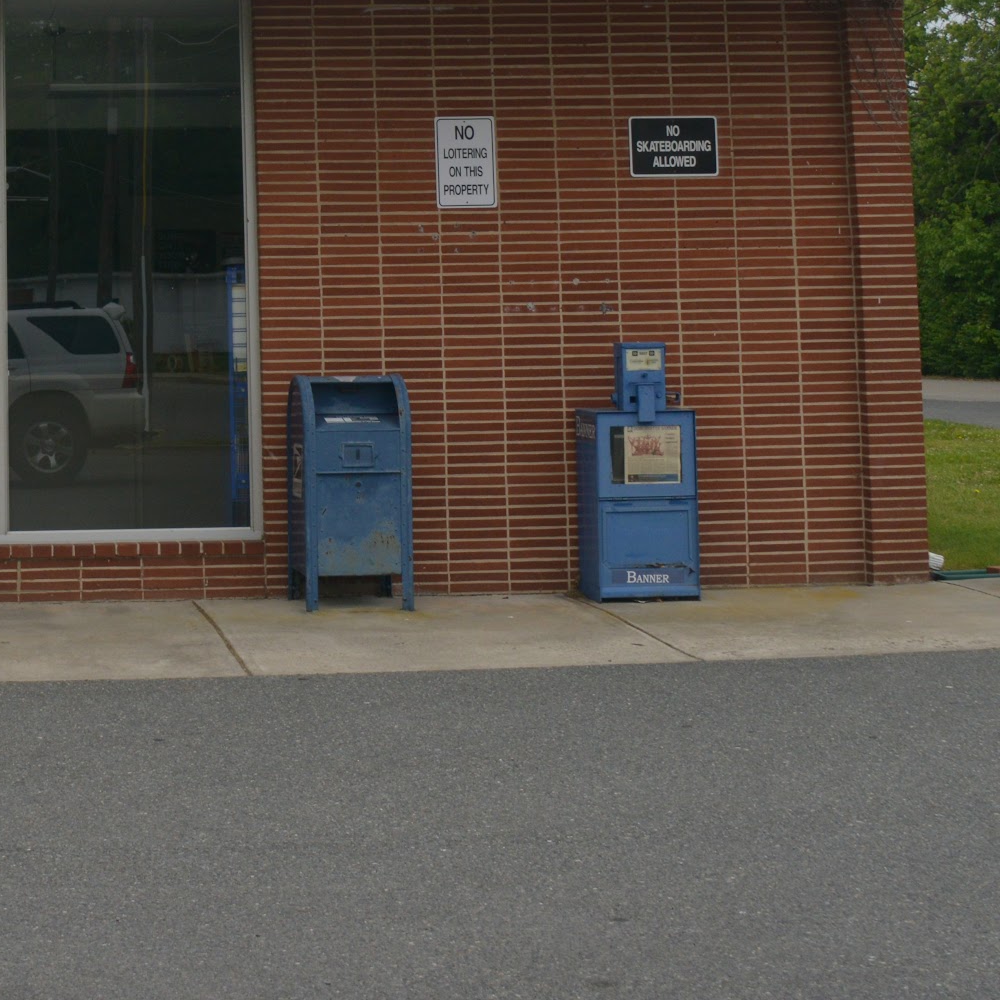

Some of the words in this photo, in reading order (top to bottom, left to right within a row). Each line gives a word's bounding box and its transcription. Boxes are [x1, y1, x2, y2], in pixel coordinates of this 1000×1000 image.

[454, 125, 475, 140] NO
[665, 124, 681, 137] NO
[443, 147, 488, 159] LOITERING
[636, 140, 712, 153] SKATEBOARDING
[652, 155, 697, 168] ALLOWED
[448, 166, 462, 177] ON
[464, 165, 483, 177] THIS
[443, 184, 489, 196] PROPERTY
[626, 570, 670, 584] BANNER
